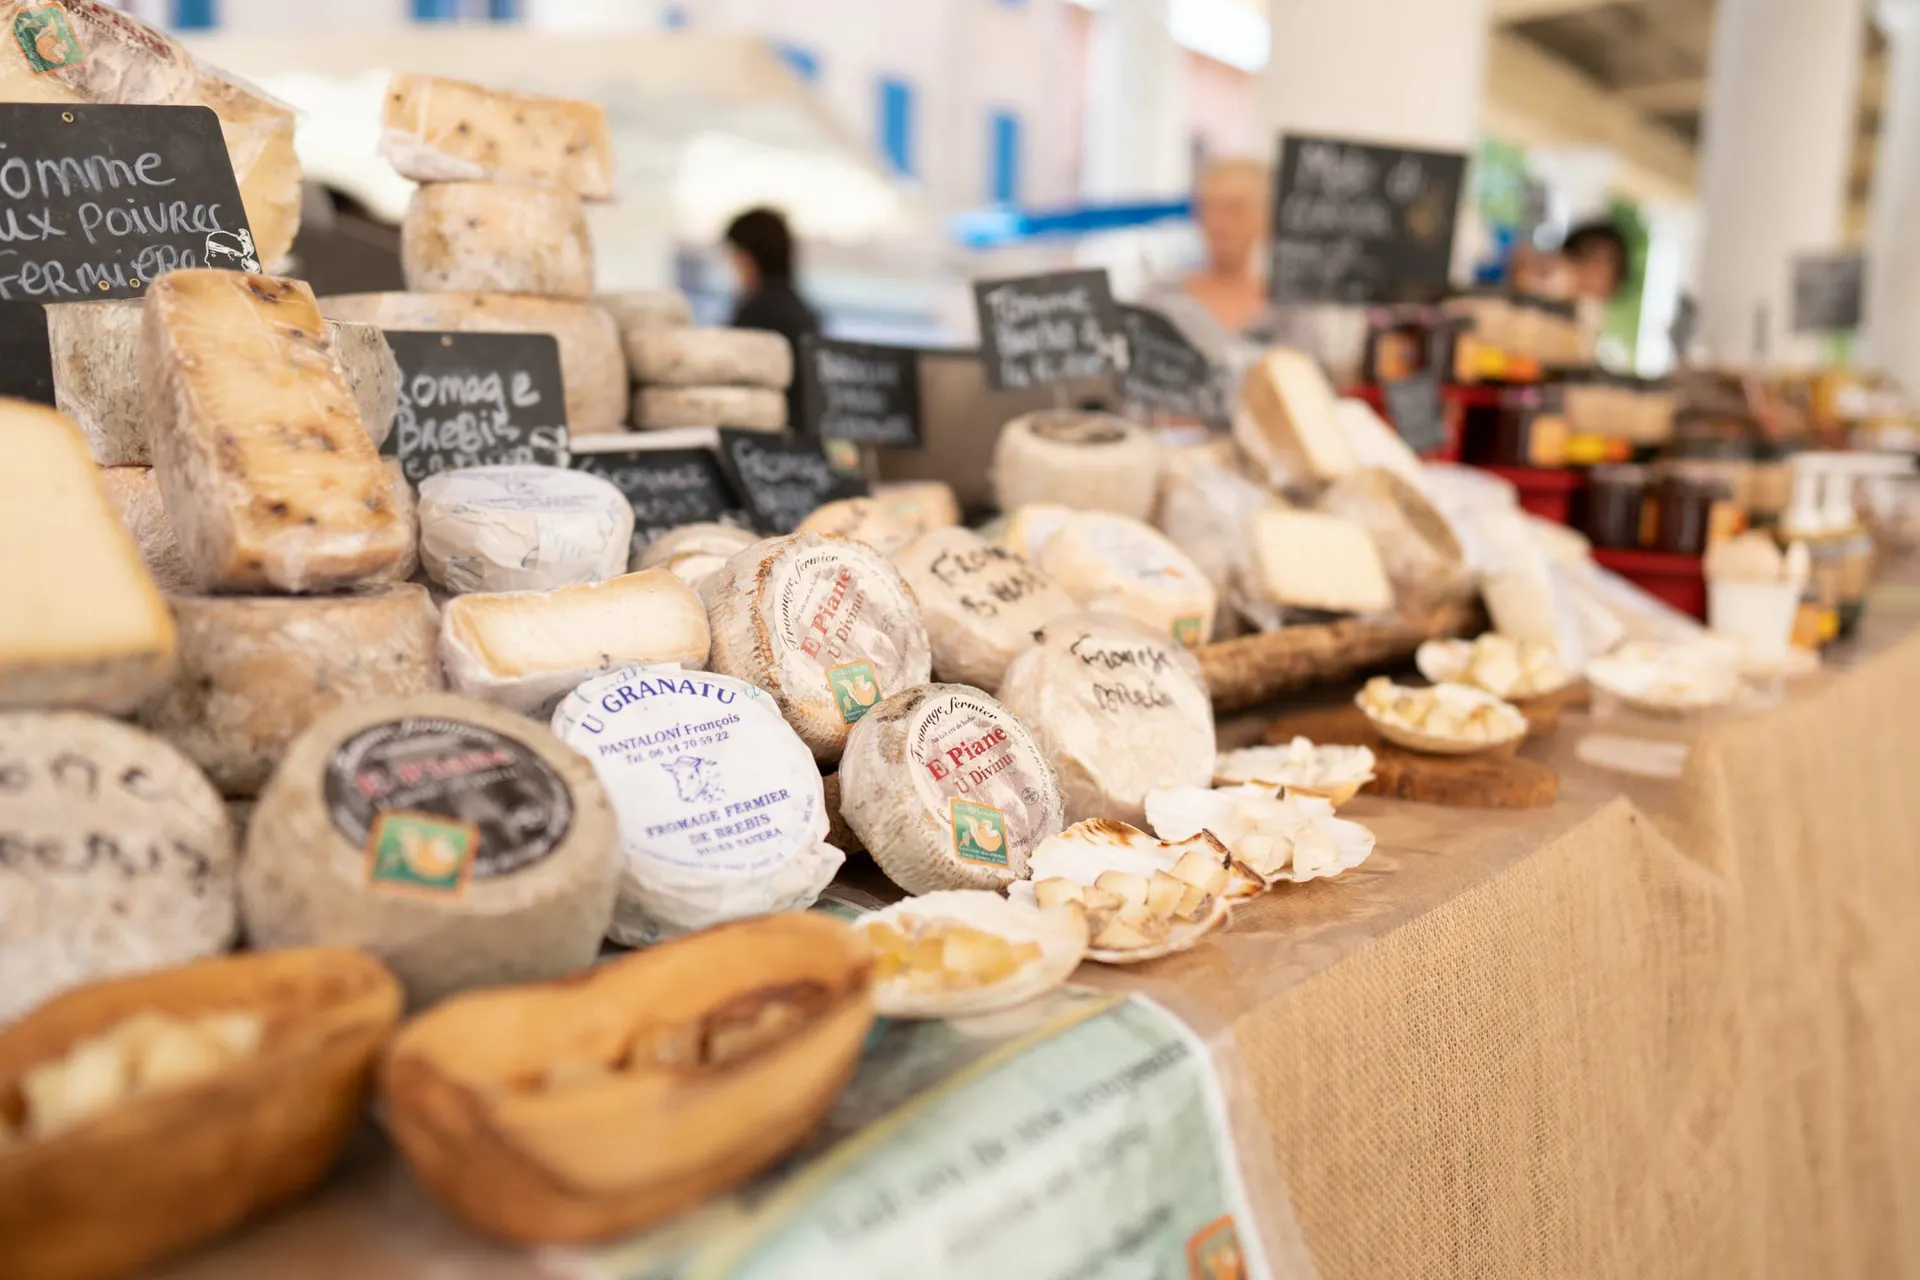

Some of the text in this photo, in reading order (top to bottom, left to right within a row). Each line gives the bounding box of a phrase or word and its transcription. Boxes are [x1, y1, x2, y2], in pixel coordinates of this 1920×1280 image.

[0, 143, 176, 200] omme
[811, 567, 852, 636] Piane
[828, 643, 842, 660] U
[835, 589, 867, 644] Divinu
[801, 636, 822, 661] E
[581, 713, 605, 735] U
[600, 678, 737, 714] GRANATU
[683, 713, 741, 736] François
[910, 696, 998, 766] Fromage fermier
[682, 738, 698, 750] 70
[715, 731, 730, 743] 22
[926, 727, 1008, 782] E Piane
[953, 754, 1014, 794] U Divinu
[645, 810, 721, 838] FROMAGE
[724, 788, 791, 817] FERMIER
[714, 813, 771, 840] BREBIS
